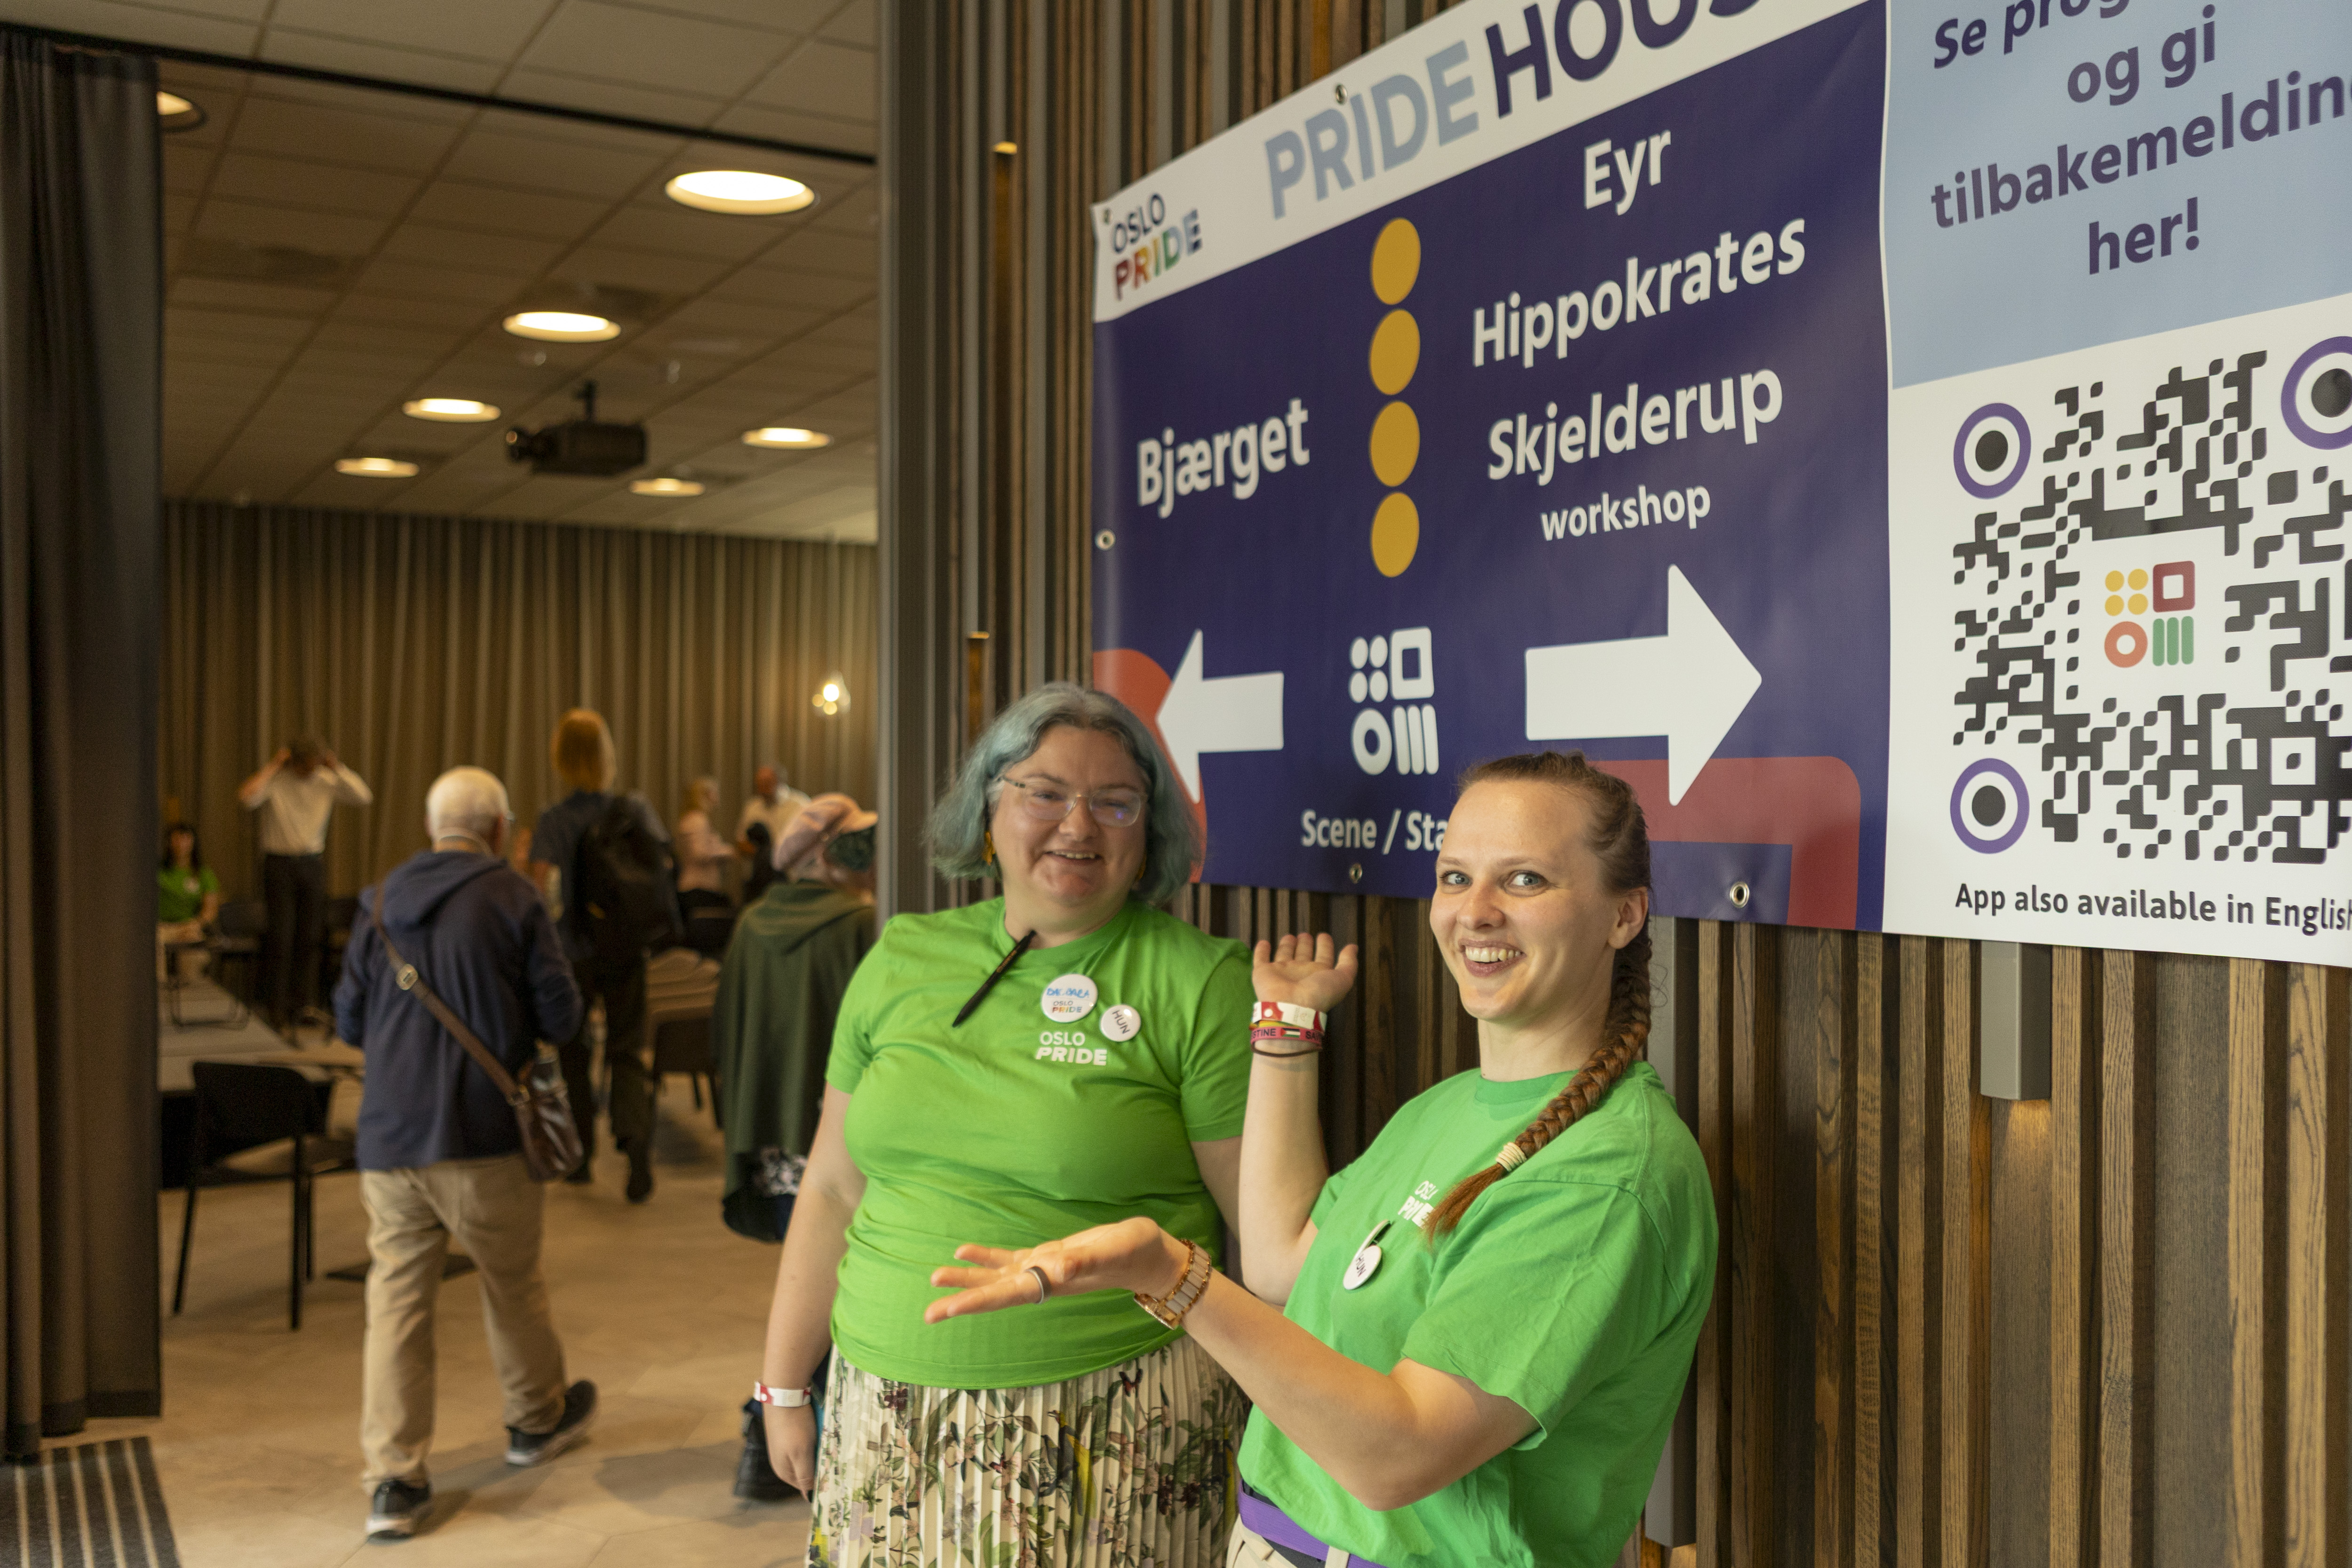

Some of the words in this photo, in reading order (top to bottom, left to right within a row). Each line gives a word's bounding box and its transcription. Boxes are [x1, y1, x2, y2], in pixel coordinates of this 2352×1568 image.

[1934, 17, 1987, 69] Se
[2067, 46, 2139, 106] og
[2161, 4, 2216, 89] gi
[1264, 40, 1479, 220] PRIDE
[1931, 71, 2352, 229] tilbakemeldin
[1584, 130, 1671, 216] Eyr
[1112, 193, 1166, 255] OSLO
[1113, 208, 1203, 302] PRIDE
[2089, 196, 2200, 275] her!
[1473, 218, 1805, 369] Hippokrates
[1137, 398, 1310, 519] Bjærget
[1488, 369, 1783, 486] Skjelderup
[1540, 485, 1711, 541] workshop
[1301, 808, 1377, 849] Scene
[1955, 883, 2006, 916] App
[2015, 885, 2068, 914] also
[2078, 890, 2217, 922] available
[2227, 893, 2254, 924] in
[1035, 1047, 1107, 1066] PRIDE
[1039, 1031, 1086, 1046] OSLO
[1112, 1010, 1131, 1035] HUN
[1356, 1253, 1367, 1278] HUN
